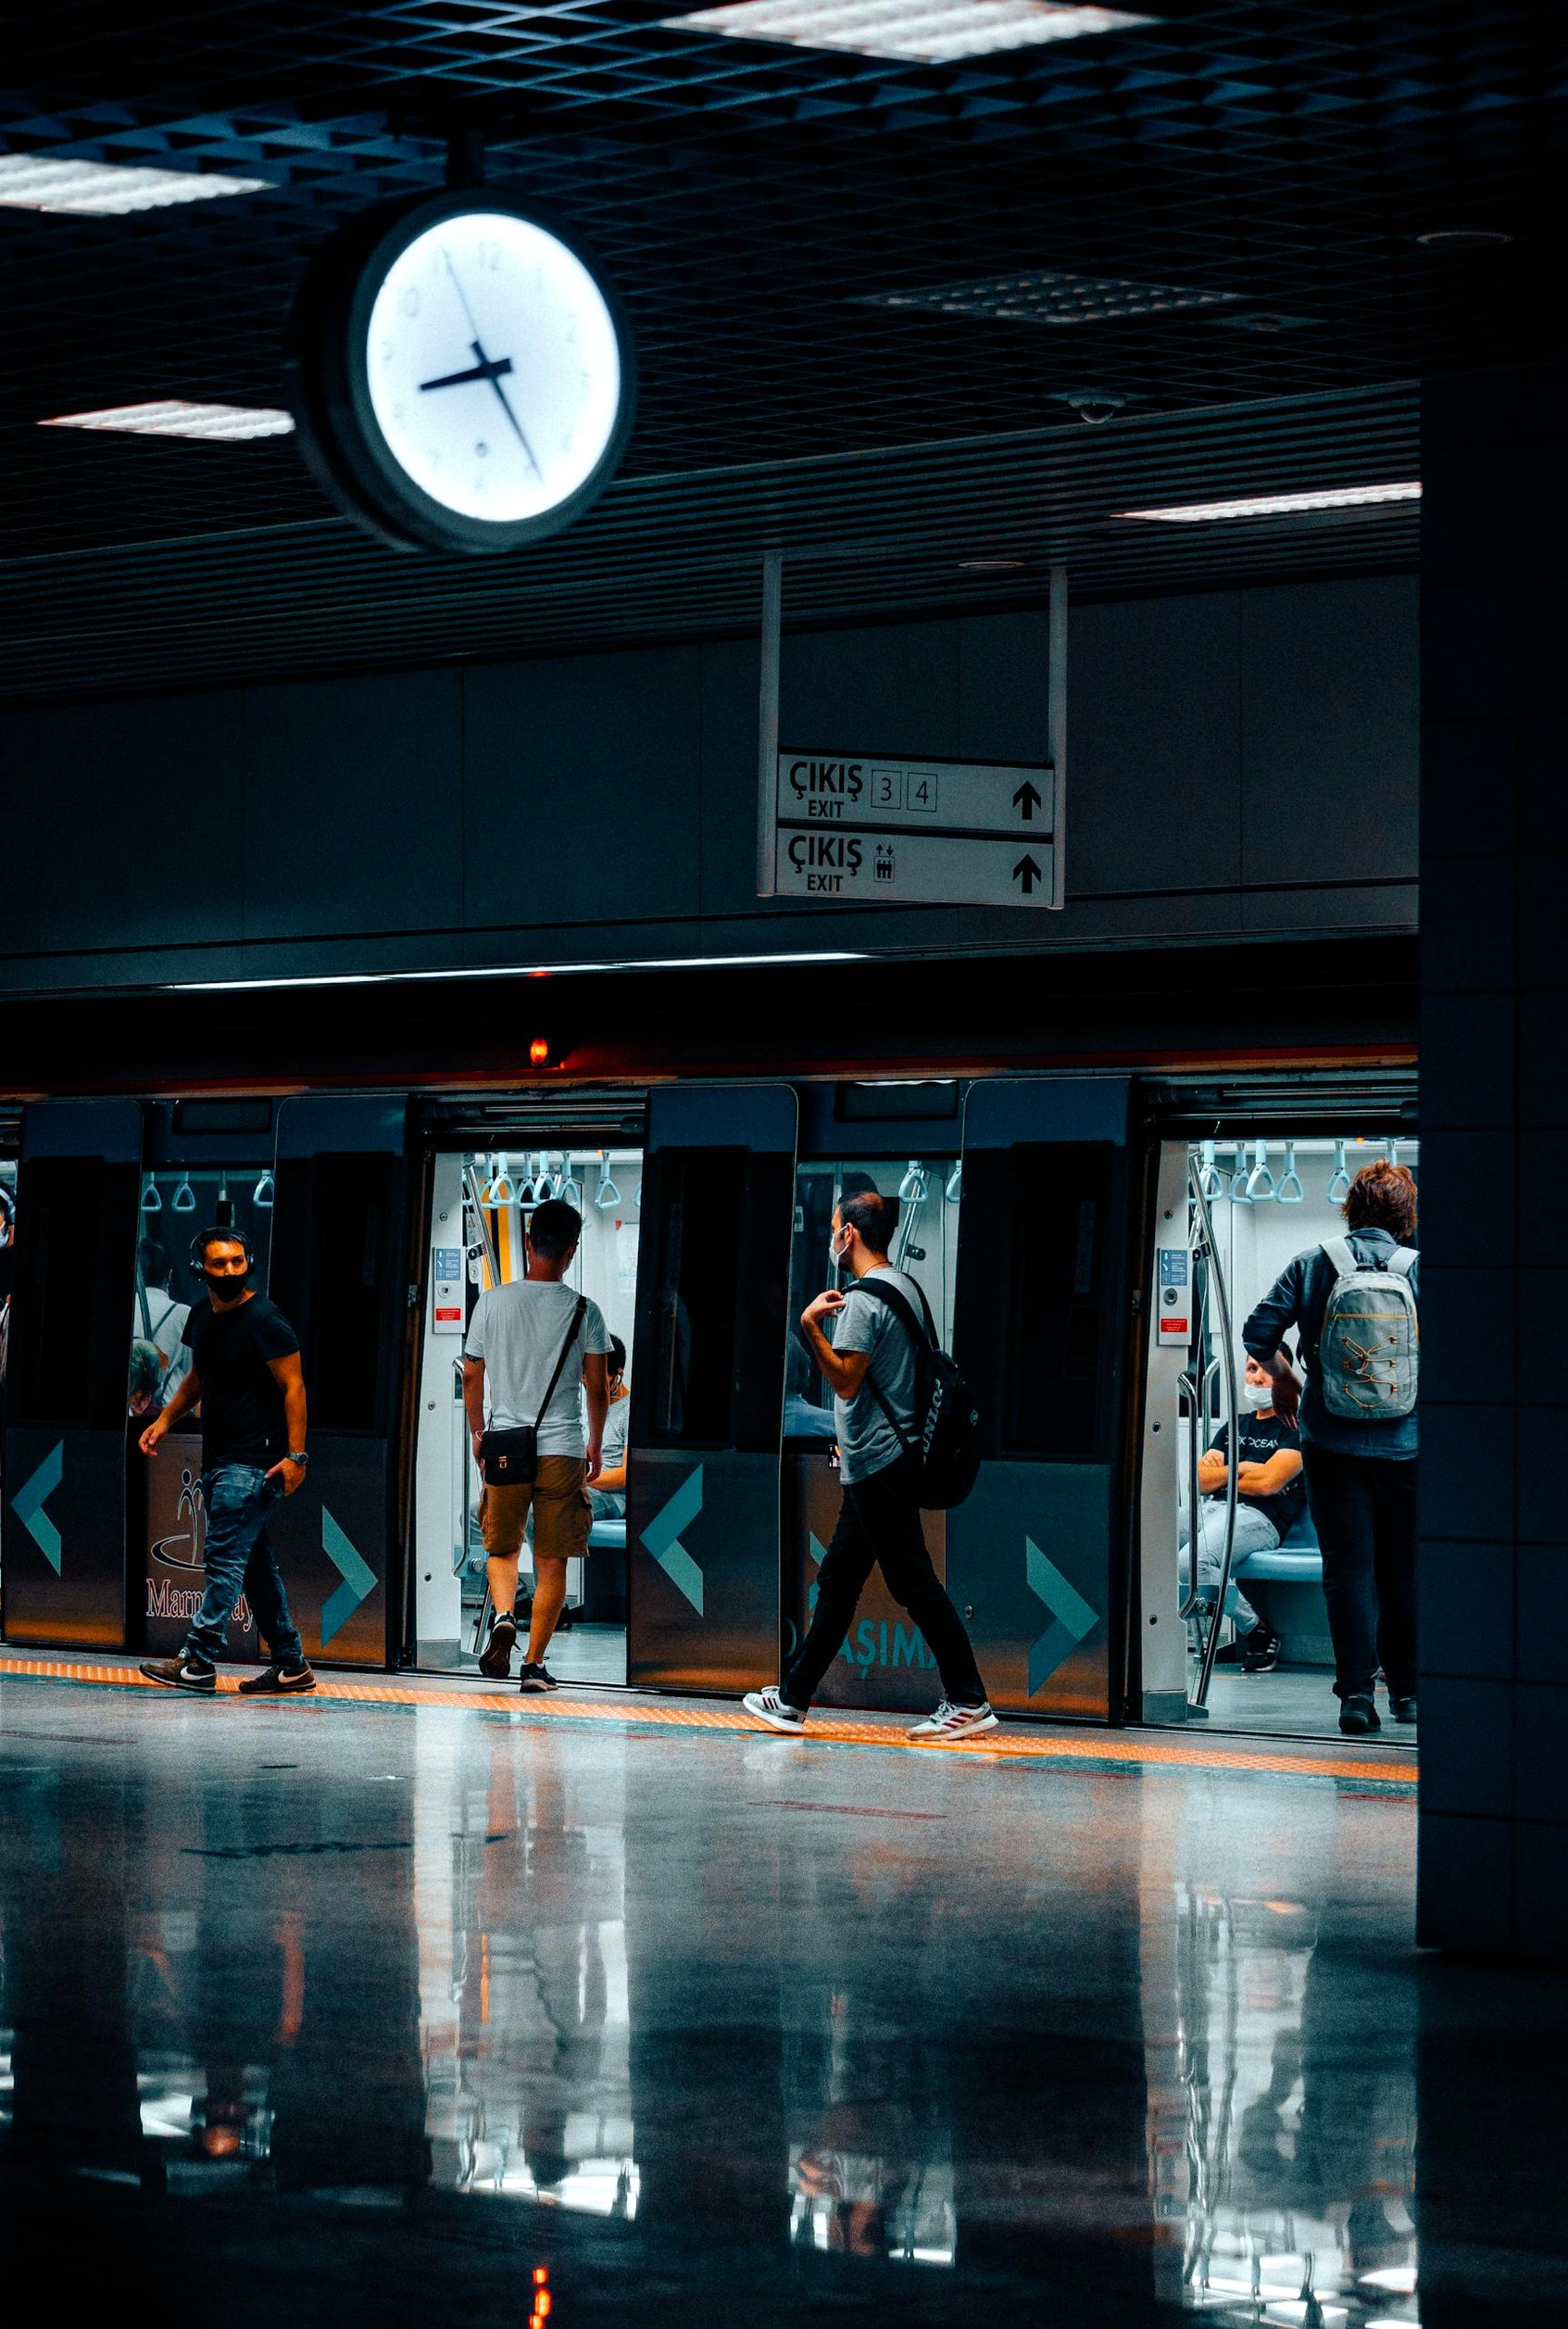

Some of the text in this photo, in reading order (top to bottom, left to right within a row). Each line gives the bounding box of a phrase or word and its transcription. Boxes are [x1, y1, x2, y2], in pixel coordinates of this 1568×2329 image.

[790, 762, 933, 805] ÇIKIŞ 3 4
[807, 799, 845, 818] EXIT
[788, 836, 862, 875] ÇIKIŞ
[806, 873, 844, 893] EXIT
[146, 1578, 253, 1632] Maray
